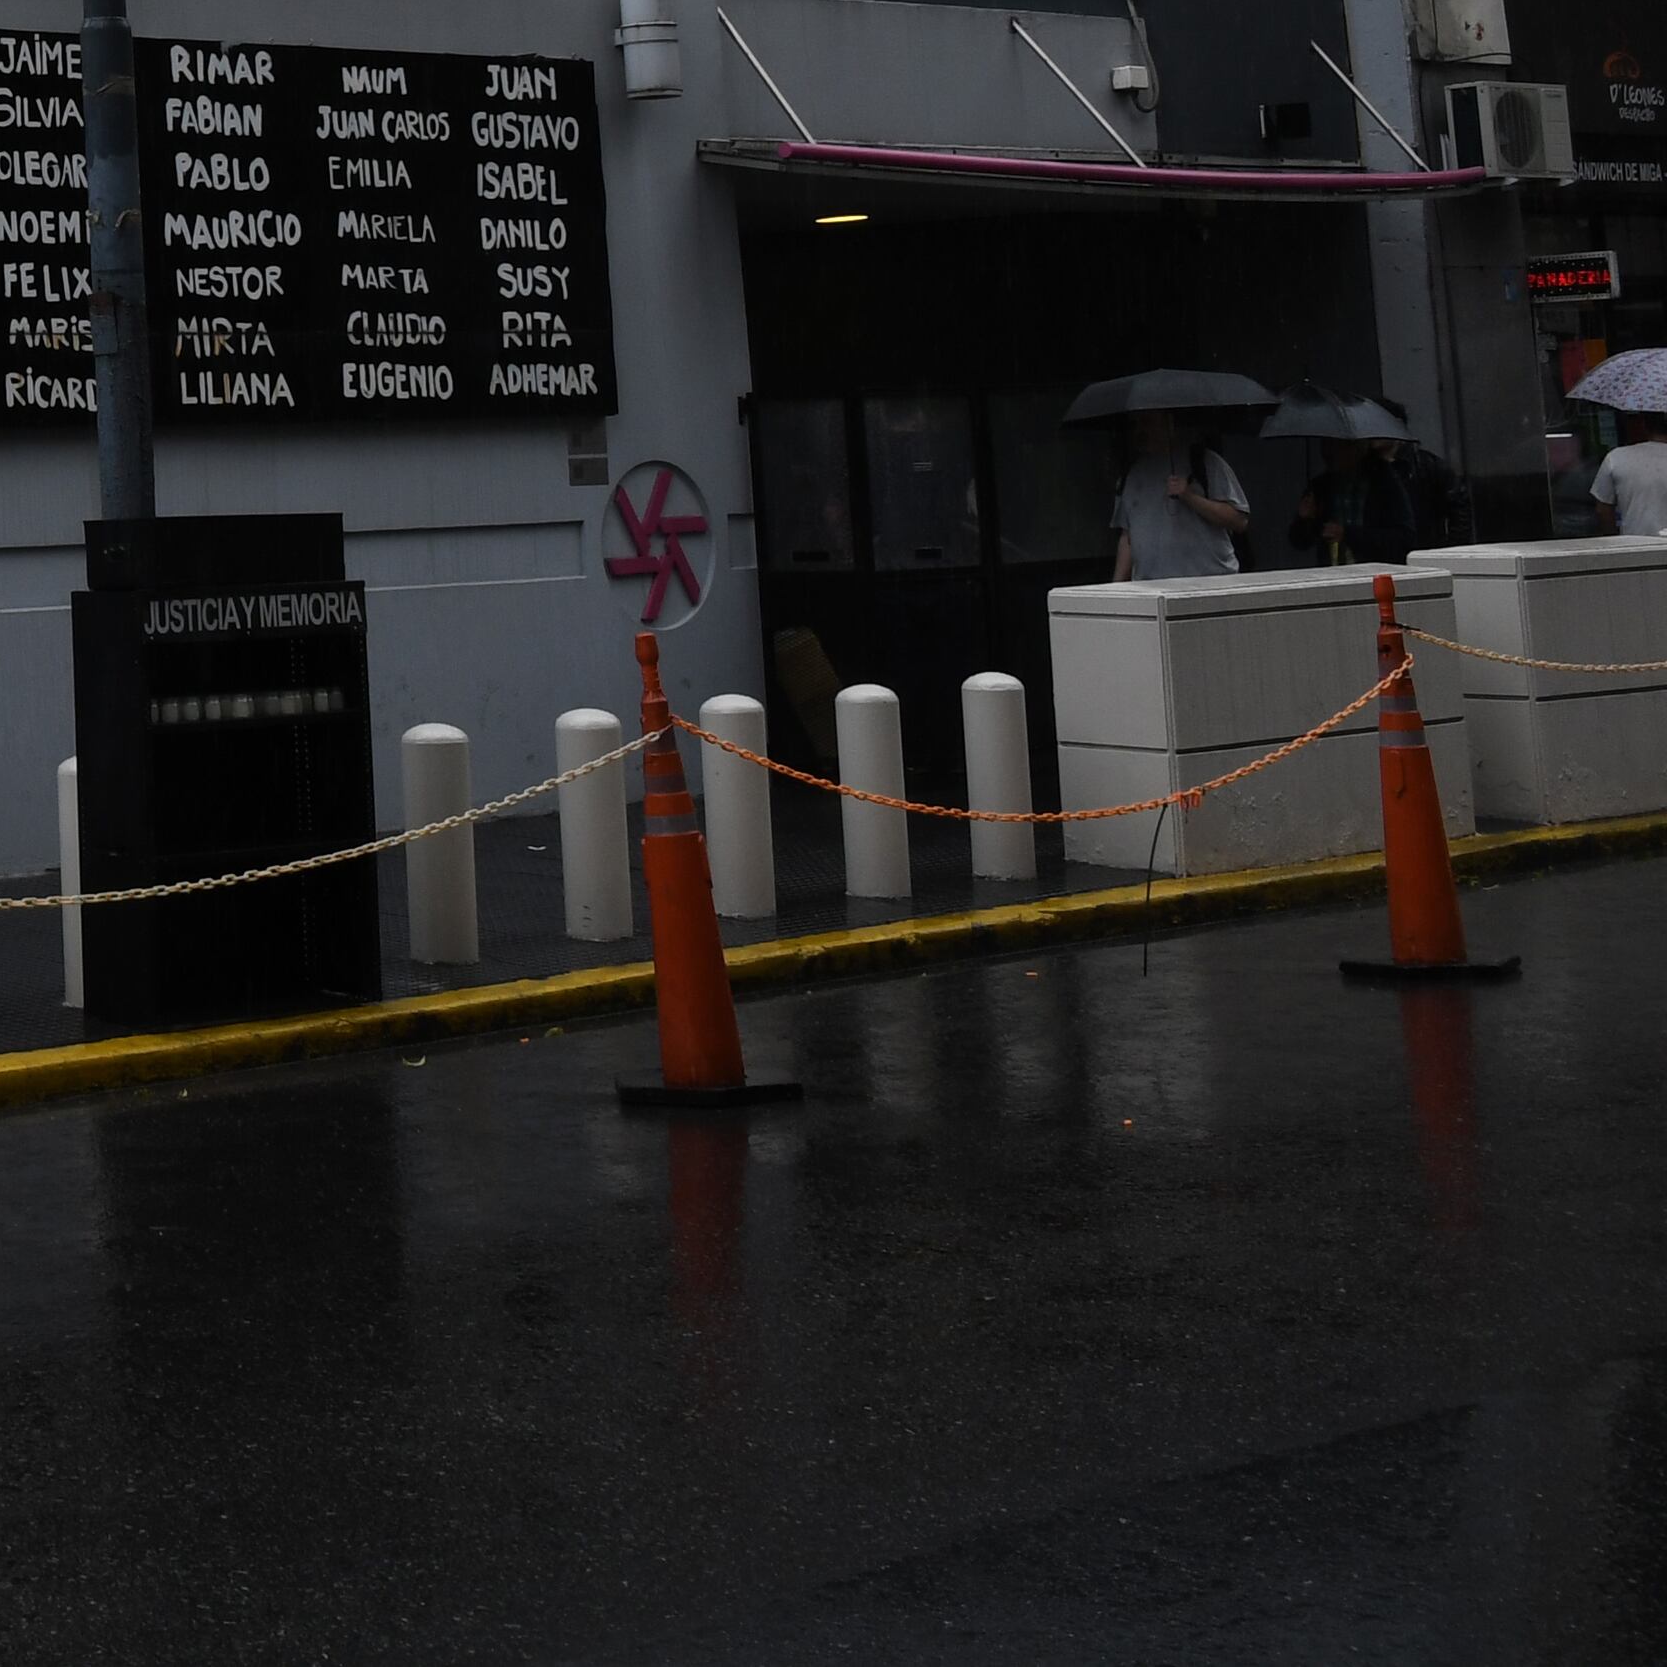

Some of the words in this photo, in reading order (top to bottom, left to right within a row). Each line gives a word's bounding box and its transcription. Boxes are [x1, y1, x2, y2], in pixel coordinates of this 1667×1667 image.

[170, 45, 275, 85] RIMAR
[342, 66, 408, 95] NAUM
[485, 64, 557, 101] JUAN
[166, 95, 263, 136] FABIAN
[316, 105, 374, 141] JUAN
[381, 110, 450, 143] CARLOS
[471, 111, 579, 150] GUSTAVO
[175, 152, 270, 192] PABLO
[328, 156, 412, 191] EMILIA
[477, 162, 568, 205] ISABEL
[1625, 162, 1639, 181] DE
[1640, 163, 1662, 181] MIGA
[164, 210, 302, 251] MAURICIO
[337, 210, 436, 244] MARIELA
[480, 217, 567, 251] DANILO
[3, 263, 92, 303] FELIX
[175, 266, 284, 300] NESTOR
[341, 264, 429, 294] MARTA
[497, 262, 570, 300] SUSY
[175, 316, 275, 359] MIRTA
[347, 311, 446, 348] CLAUDIO
[502, 311, 572, 349] RITA
[180, 371, 295, 407] LILIANA
[342, 361, 454, 400] EUGENIO
[489, 363, 598, 397] ADHEMAR
[144, 596, 241, 635] JUSTICIA
[240, 596, 255, 629] Y
[258, 591, 363, 629] MEMORIA
